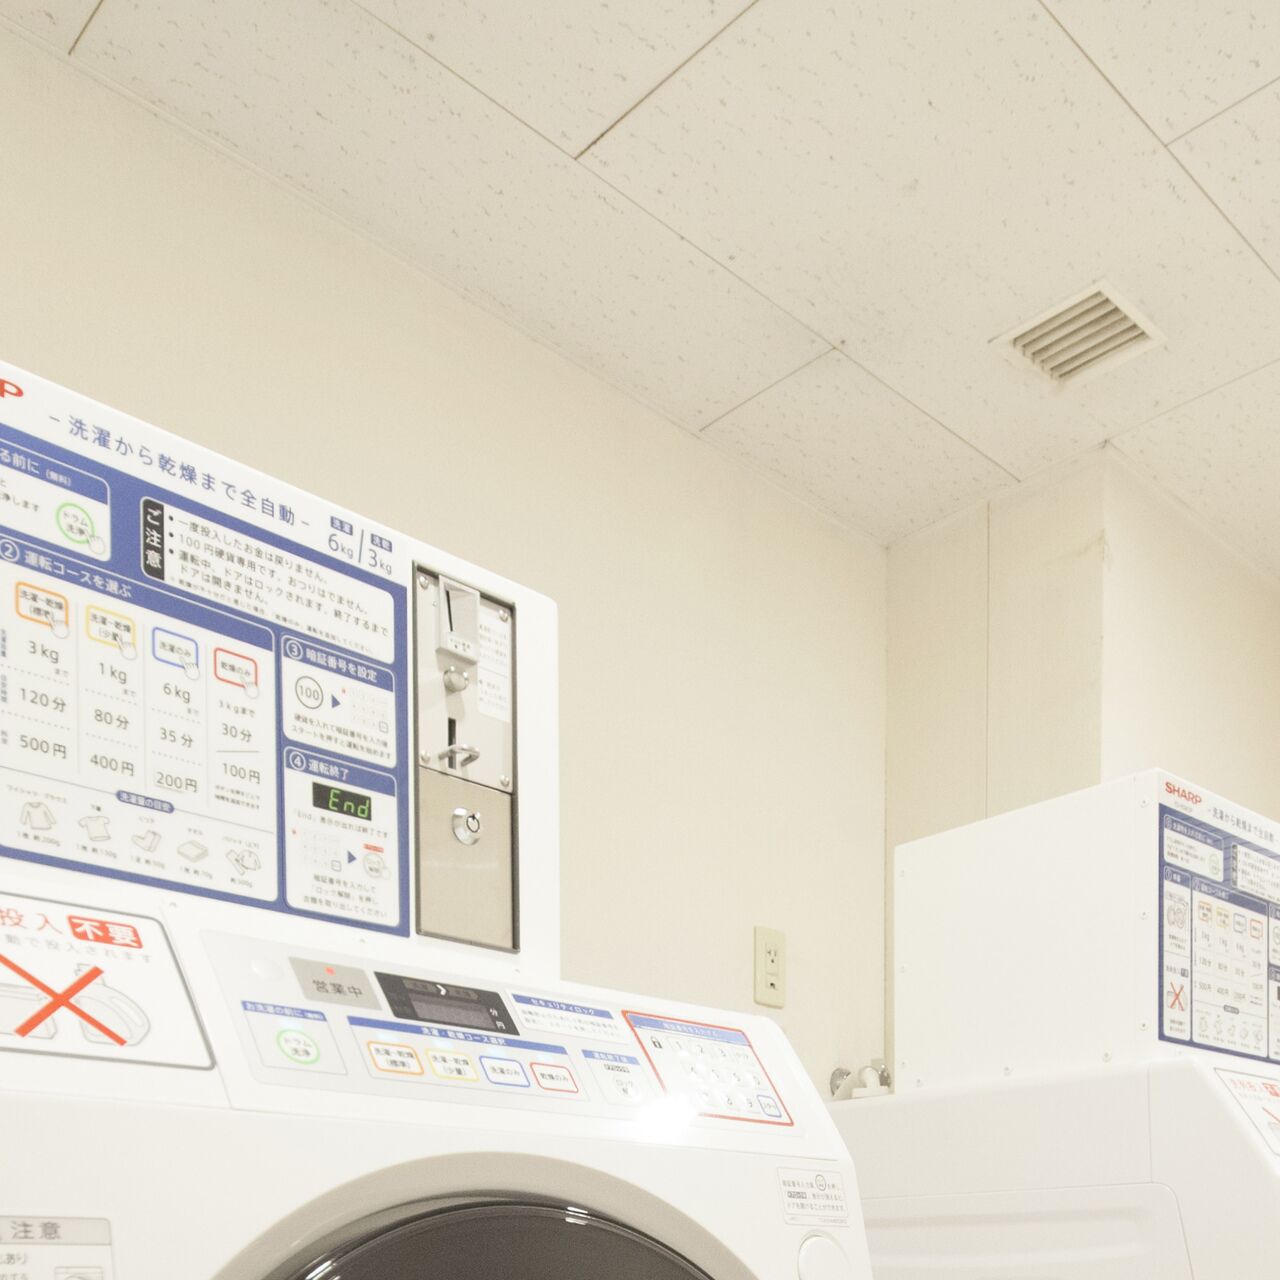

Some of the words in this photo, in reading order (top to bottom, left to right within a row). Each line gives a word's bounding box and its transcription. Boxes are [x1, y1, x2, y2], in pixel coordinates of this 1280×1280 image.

[144, 504, 163, 571] ご注意
[177, 515, 328, 586] 一度投入したお金は戻りません。
[23, 548, 132, 600] 運転コースを選ぶ
[179, 562, 269, 607] ドアは開きません。
[305, 646, 377, 685] 暗証番号を設定
[298, 683, 320, 702] 100
[307, 757, 349, 782] 運転終了
[328, 786, 370, 820] End
[1165, 781, 1202, 805] SHARP
[72, 917, 140, 947] 不要
[312, 979, 363, 998] 営業中
[11, 1220, 62, 1240] 注意
